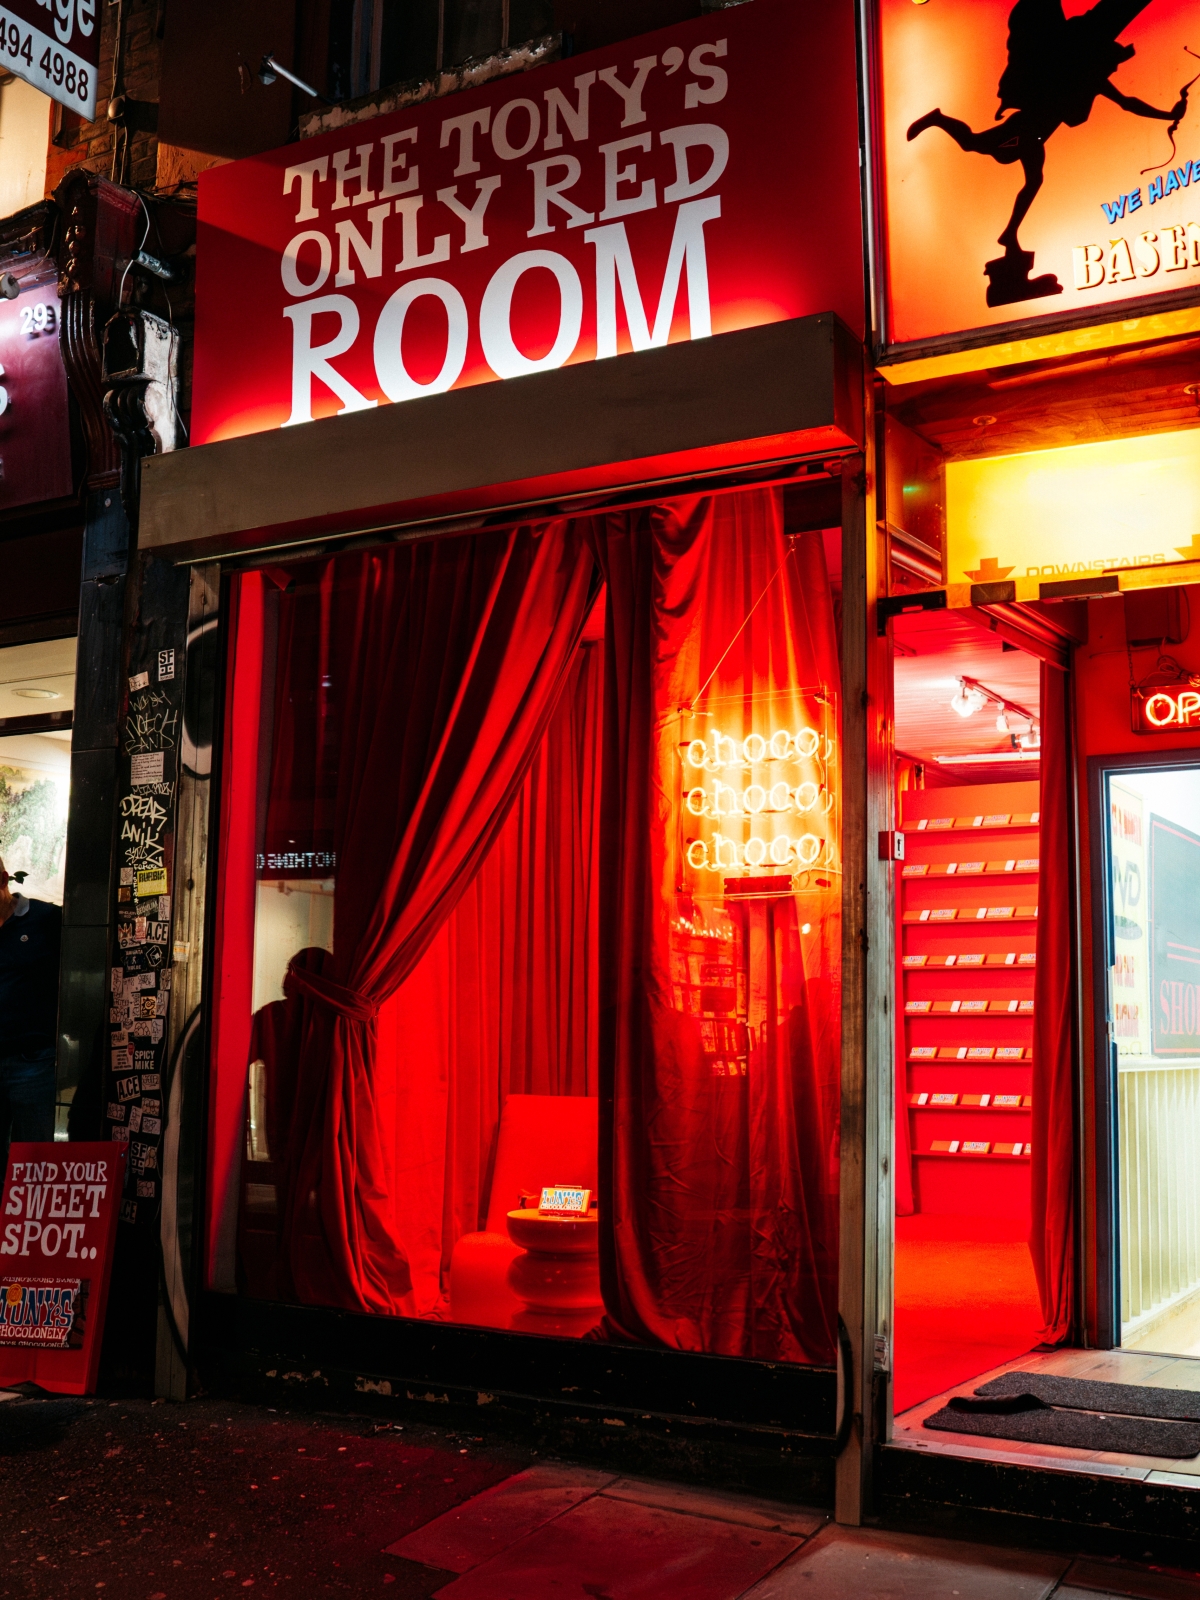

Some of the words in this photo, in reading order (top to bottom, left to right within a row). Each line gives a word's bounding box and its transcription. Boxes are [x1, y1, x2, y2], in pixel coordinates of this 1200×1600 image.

[36, 0, 95, 44] ge
[40, 46, 89, 102] 4988
[283, 126, 419, 223] THE
[439, 38, 729, 177] TONY'S
[280, 174, 501, 298] ONLY
[526, 123, 730, 238] RED
[1101, 187, 1143, 225] WE
[1147, 159, 1200, 205] HAVE
[20, 302, 48, 336] 29
[280, 194, 722, 428] ROOM
[160, 650, 174, 665] SF
[686, 726, 820, 769] choco
[686, 778, 820, 816] choco
[686, 832, 821, 869] choco
[147, 922, 169, 942] A.CE
[134, 1050, 155, 1060] SPICY
[134, 1060, 155, 1070] MIKE
[118, 1076, 140, 1099] A.CE
[12, 1161, 59, 1183] FIND
[62, 1160, 108, 1182] YOUR
[5, 1183, 107, 1220] SWEET
[0, 1220, 98, 1260] SPOT..
[0, 1325, 65, 1340] HOCOLONELY
